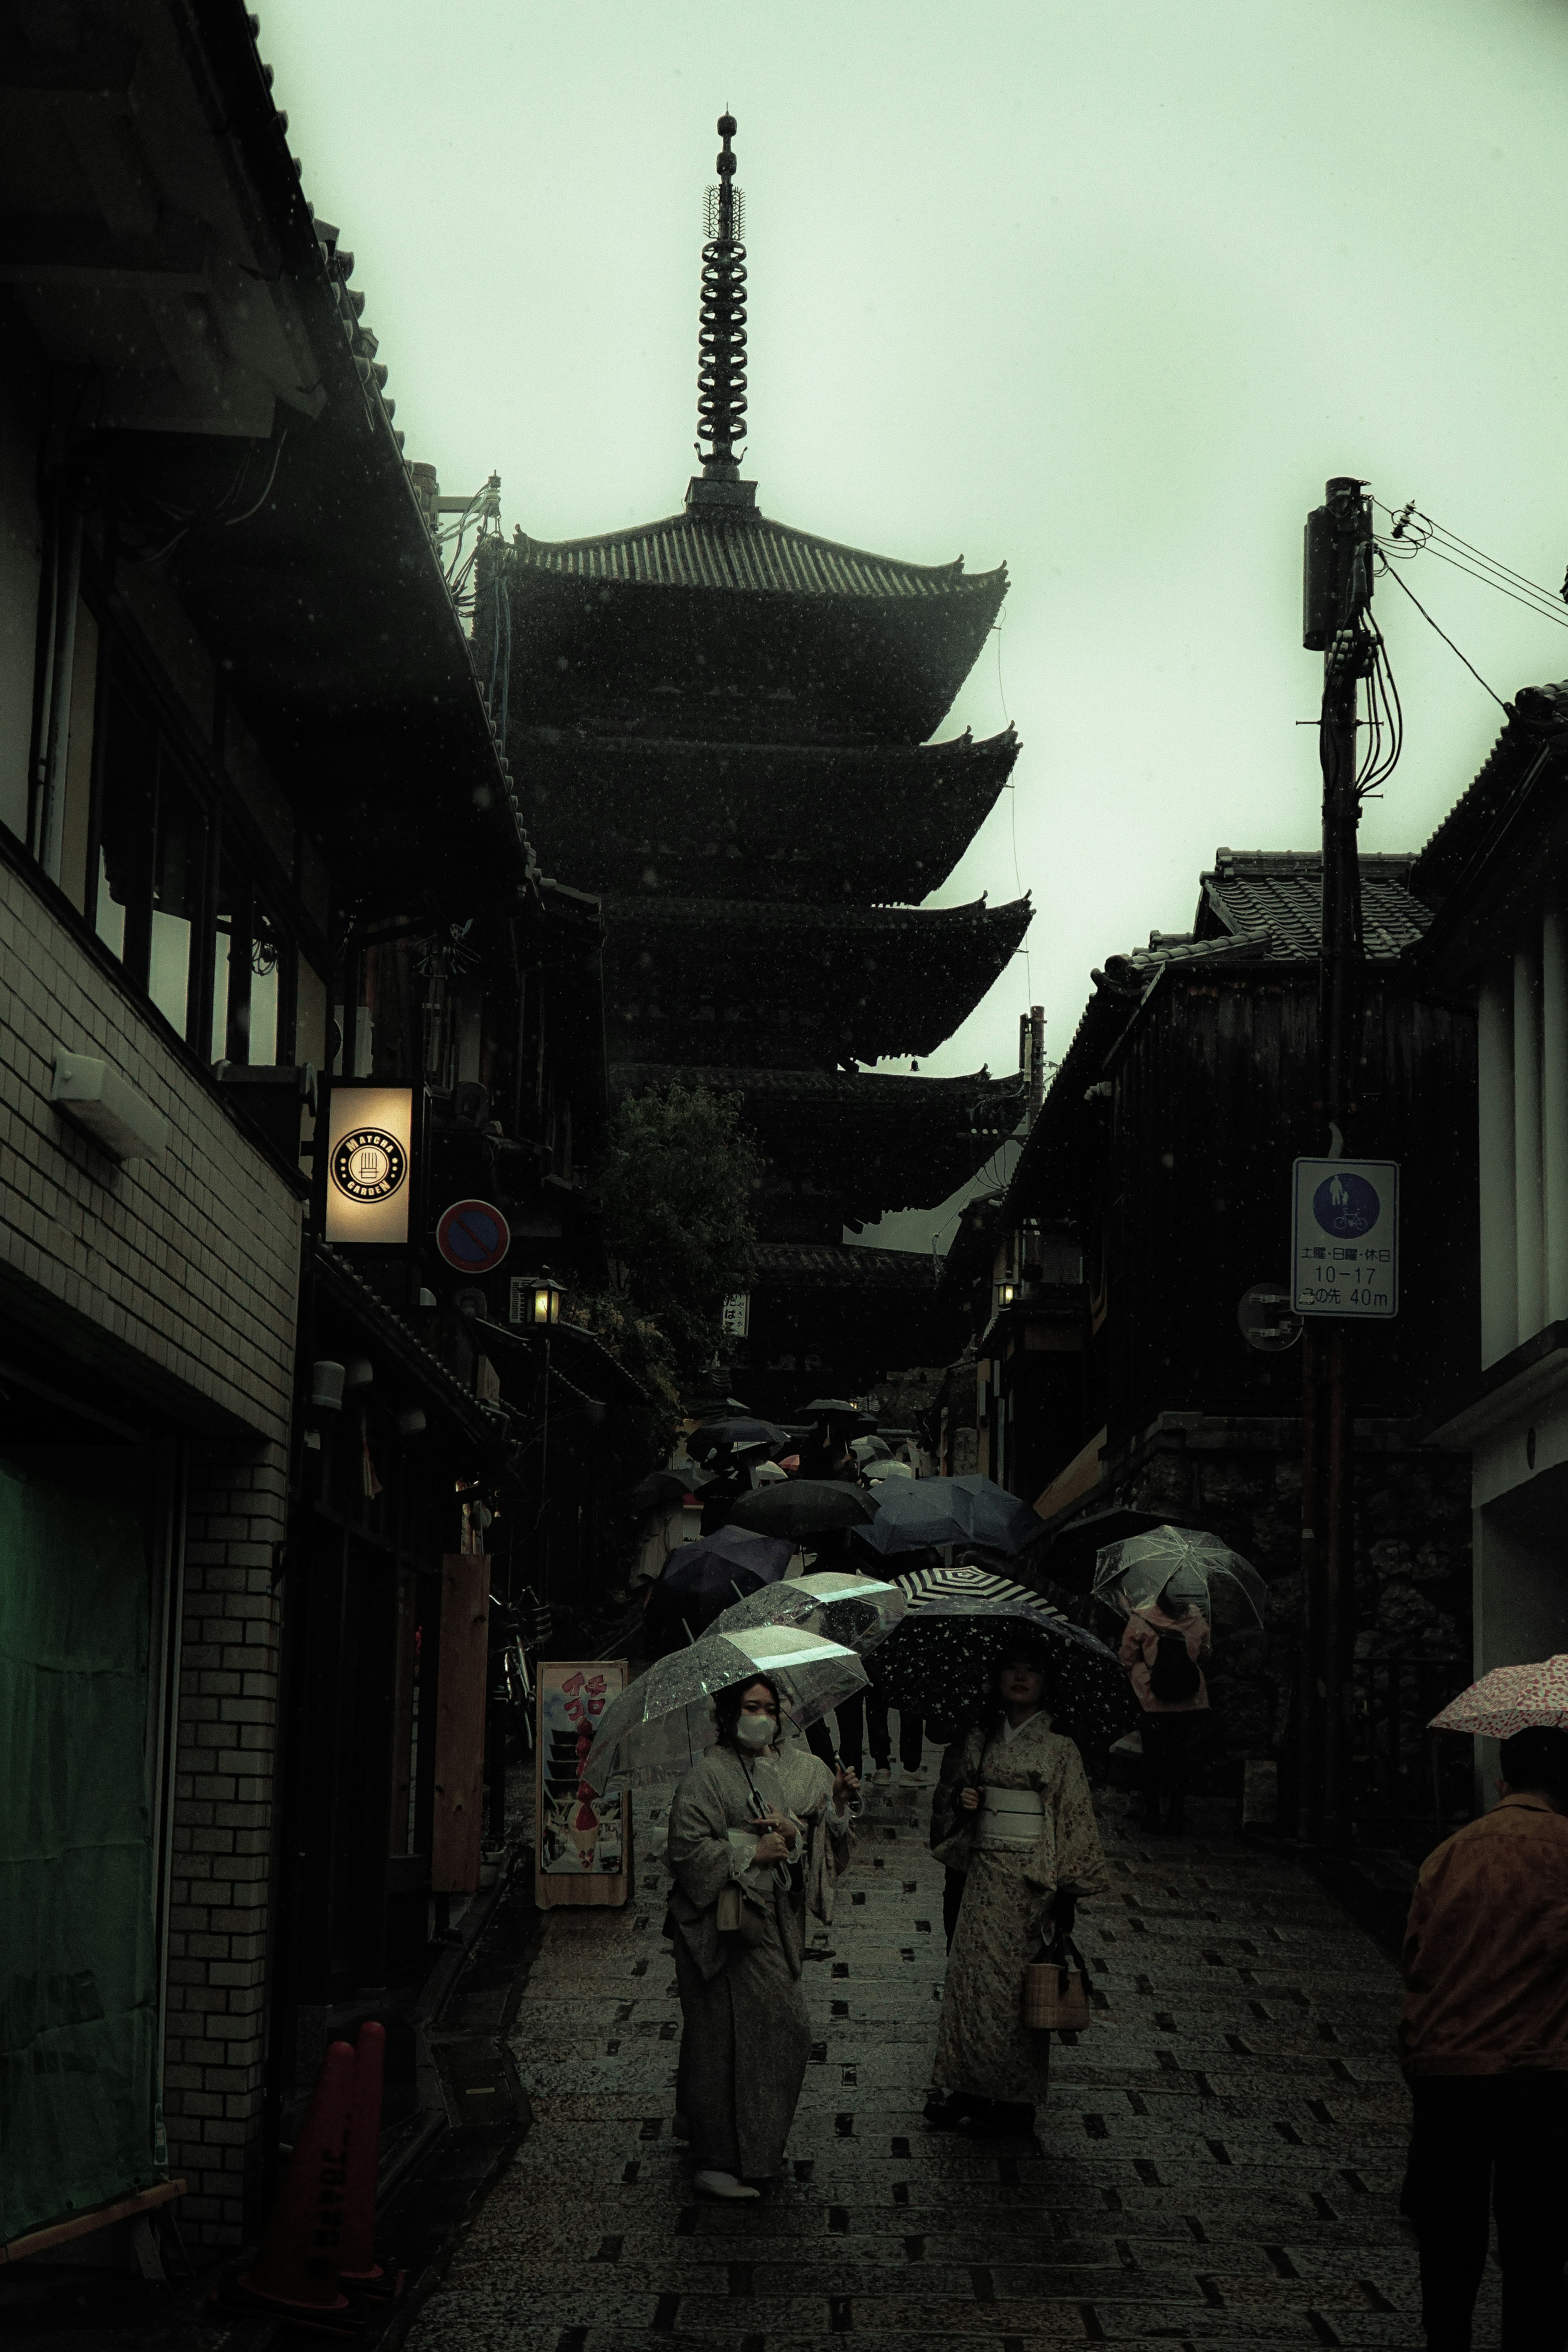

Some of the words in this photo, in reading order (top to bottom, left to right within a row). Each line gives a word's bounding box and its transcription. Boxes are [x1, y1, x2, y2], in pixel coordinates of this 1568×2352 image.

[345, 1134, 394, 1154] MATCHA
[347, 1179, 392, 1196] GARDEN
[1301, 1247, 1390, 1262] 土曜・日曜・休日
[1314, 1265, 1376, 1285] 10-17
[1350, 1289, 1388, 1307] 40m
